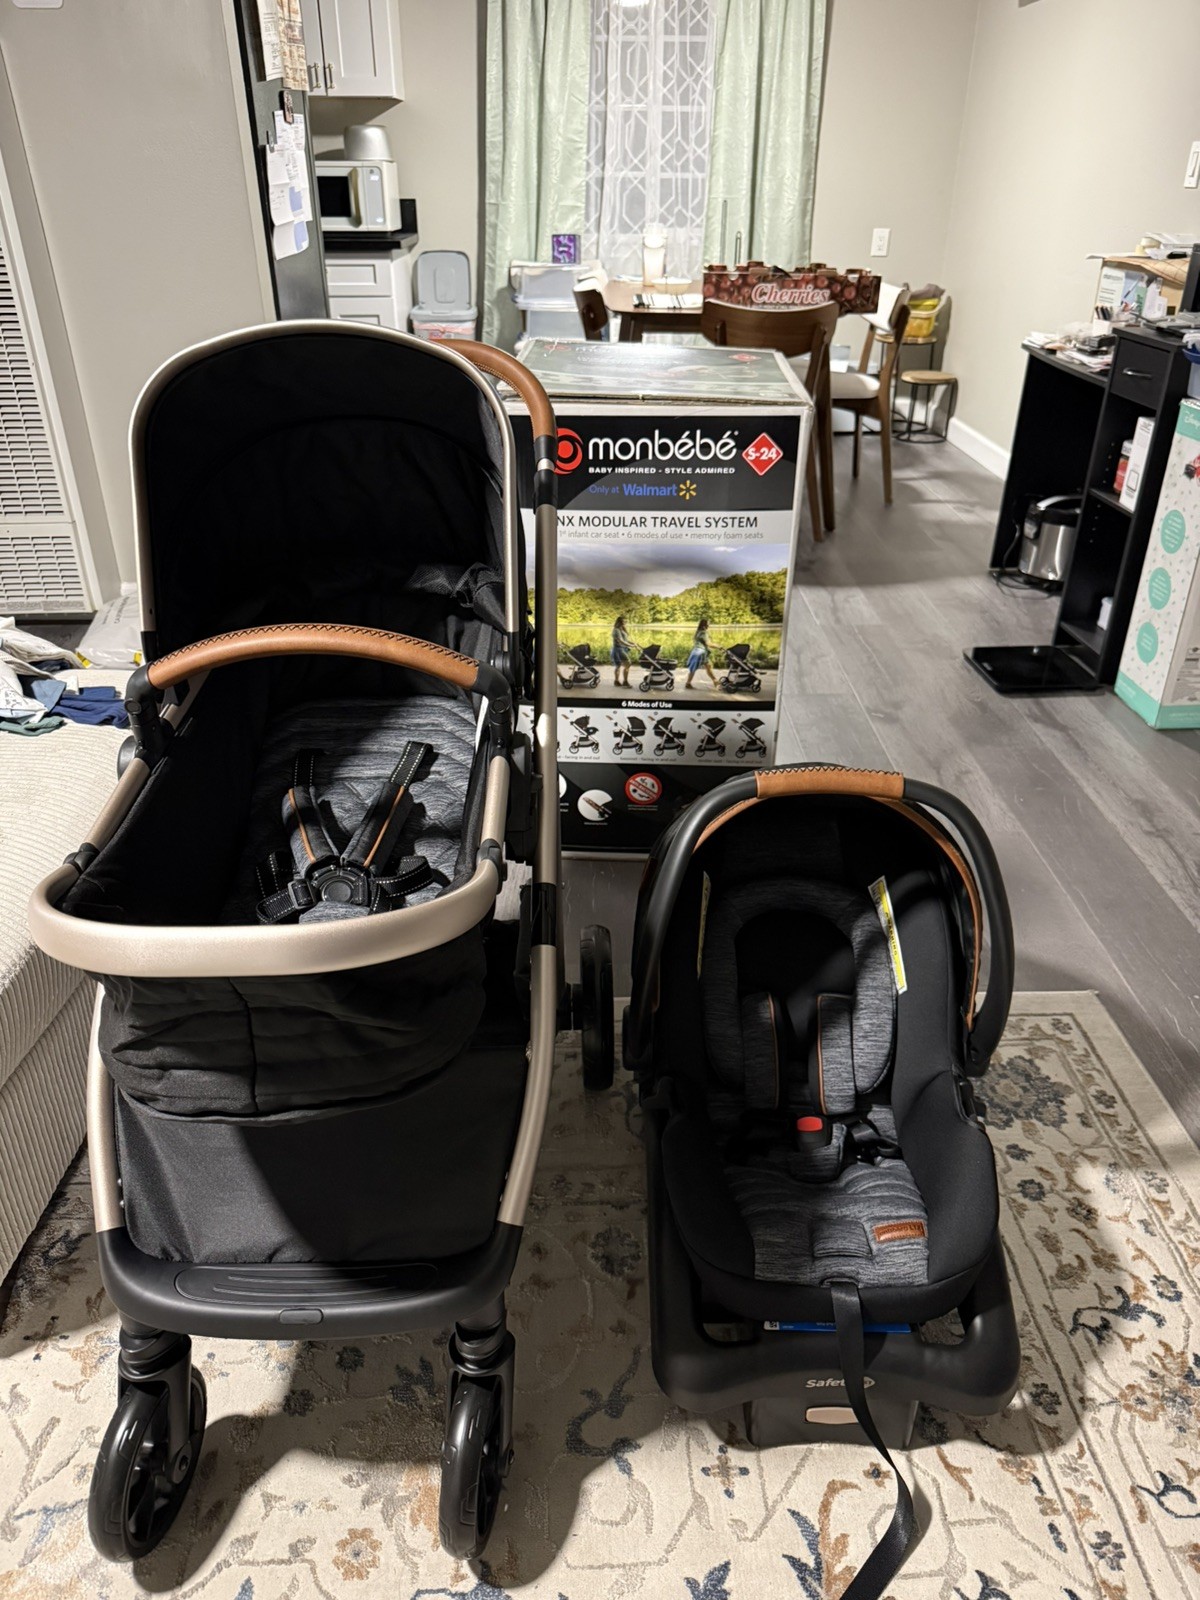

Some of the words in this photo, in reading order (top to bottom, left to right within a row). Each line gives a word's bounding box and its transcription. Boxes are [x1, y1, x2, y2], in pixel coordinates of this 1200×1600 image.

[752, 284, 830, 304] Cherries
[588, 429, 738, 461] monbébé
[747, 447, 778, 460] S-24
[589, 484, 609, 495] Only
[611, 486, 620, 494] at
[622, 483, 678, 496] Walmart
[557, 515, 575, 527] NX
[578, 515, 647, 528] MODULAR
[651, 516, 701, 528] TRAVEL
[704, 517, 759, 528] SYSTEM
[568, 530, 589, 538] infant
[634, 531, 659, 539] modes
[661, 531, 669, 539] of
[690, 533, 722, 541] memory
[724, 531, 743, 540] foam
[744, 532, 764, 540] seats
[628, 700, 650, 708] Modes
[805, 1377, 846, 1388] Safet
